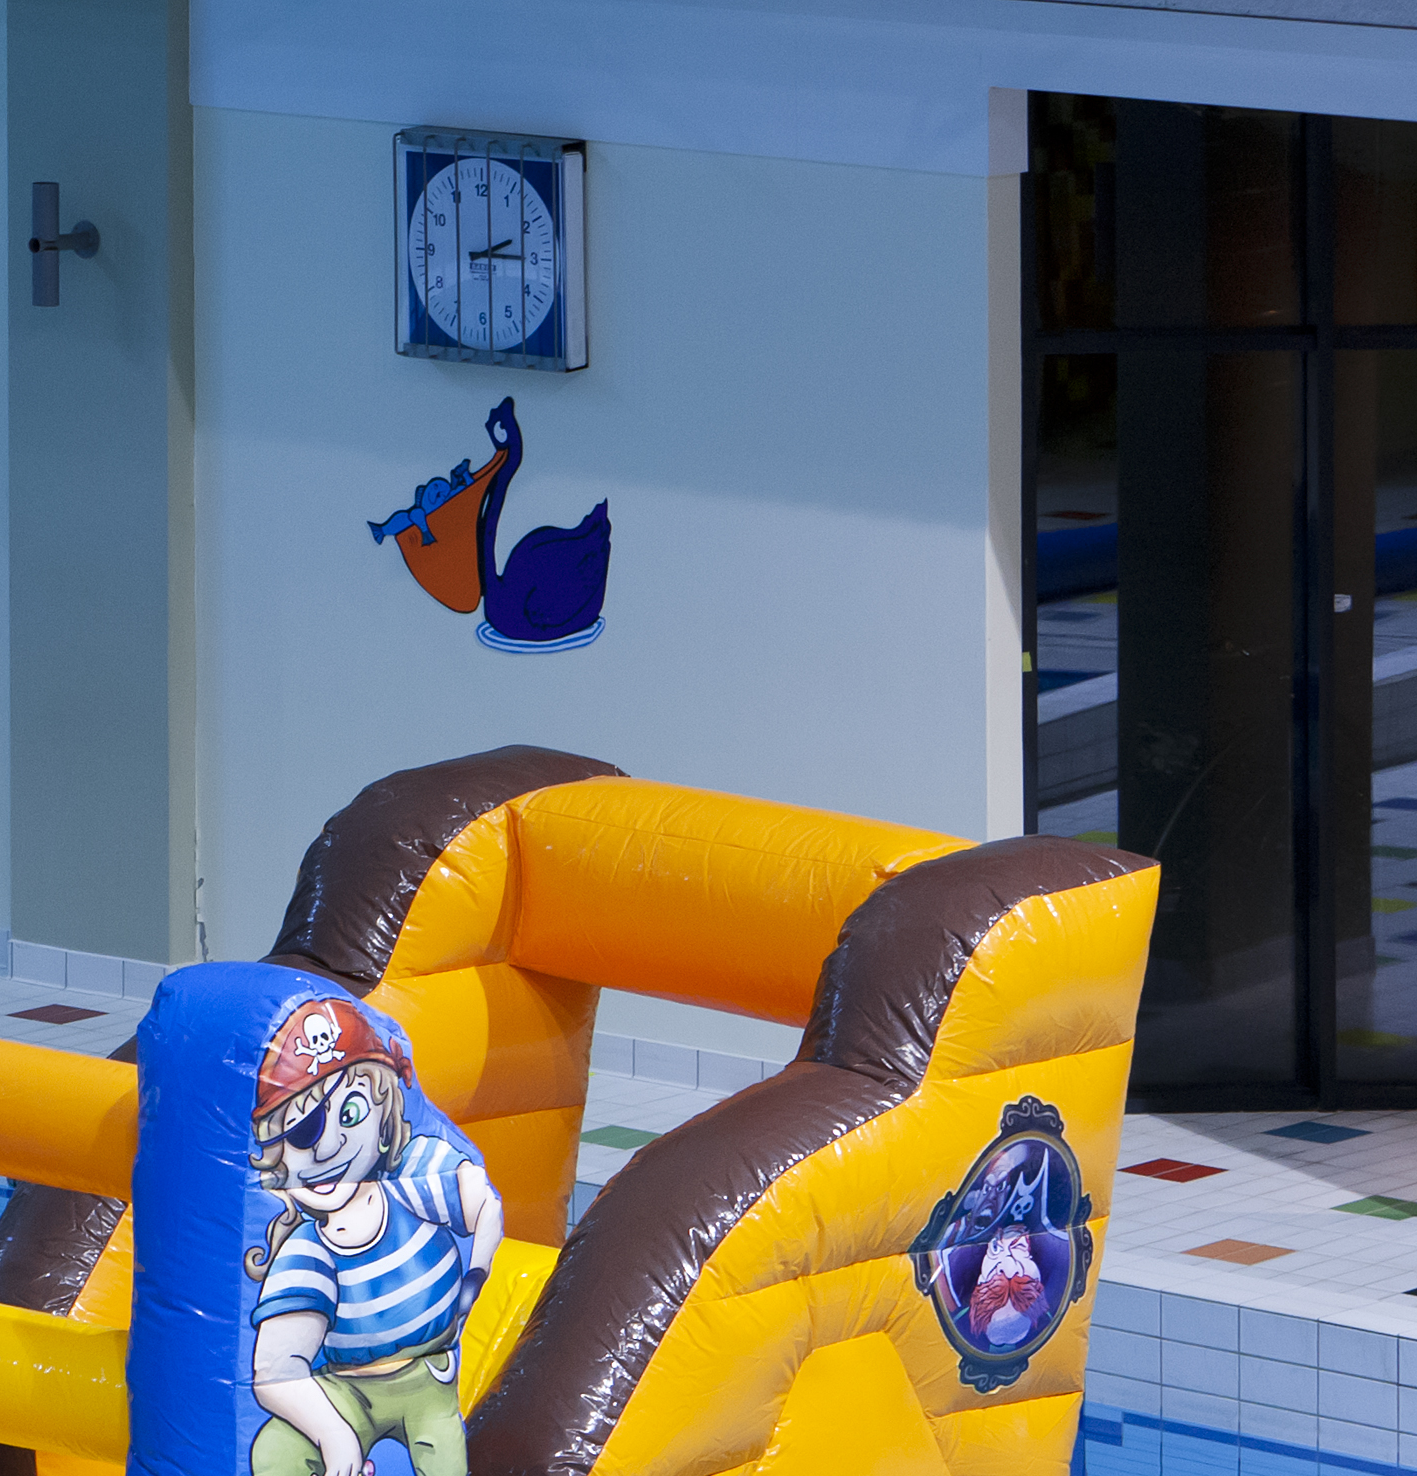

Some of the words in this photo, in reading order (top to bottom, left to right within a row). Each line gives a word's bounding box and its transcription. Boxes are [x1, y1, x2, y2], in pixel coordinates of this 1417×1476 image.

[475, 183, 488, 197] 12
[504, 194, 510, 208] 1
[435, 214, 446, 227] 10
[522, 221, 531, 234] 2
[427, 243, 435, 256] 9
[530, 252, 539, 266] 3
[435, 276, 444, 289] 8
[504, 305, 513, 318] 5
[479, 312, 487, 326] 6
